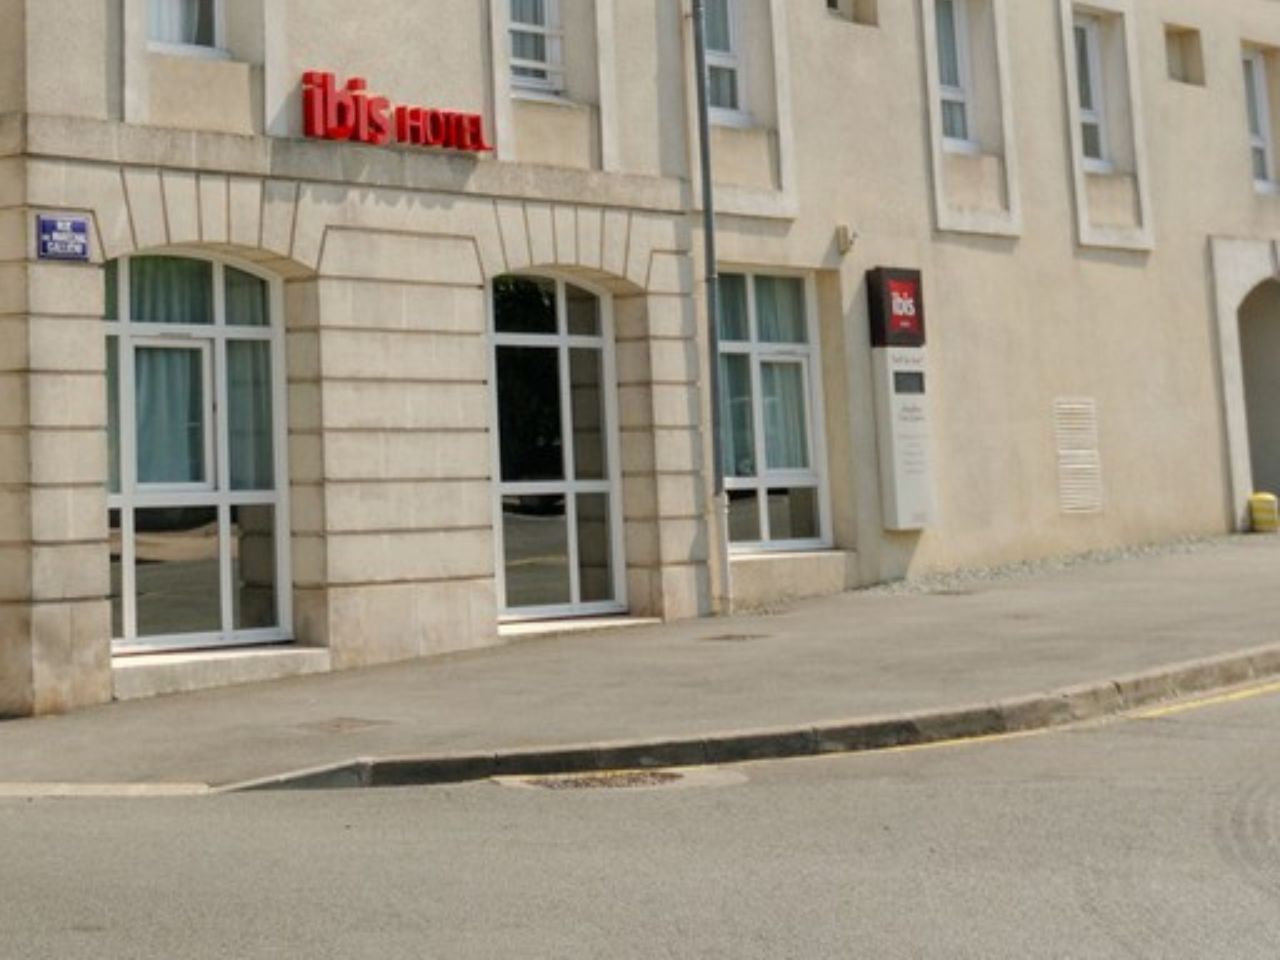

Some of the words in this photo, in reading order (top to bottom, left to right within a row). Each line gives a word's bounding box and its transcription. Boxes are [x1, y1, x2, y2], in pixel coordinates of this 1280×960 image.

[303, 71, 390, 144] ibis
[394, 106, 494, 151] HOTEL
[891, 291, 916, 316] ibis
